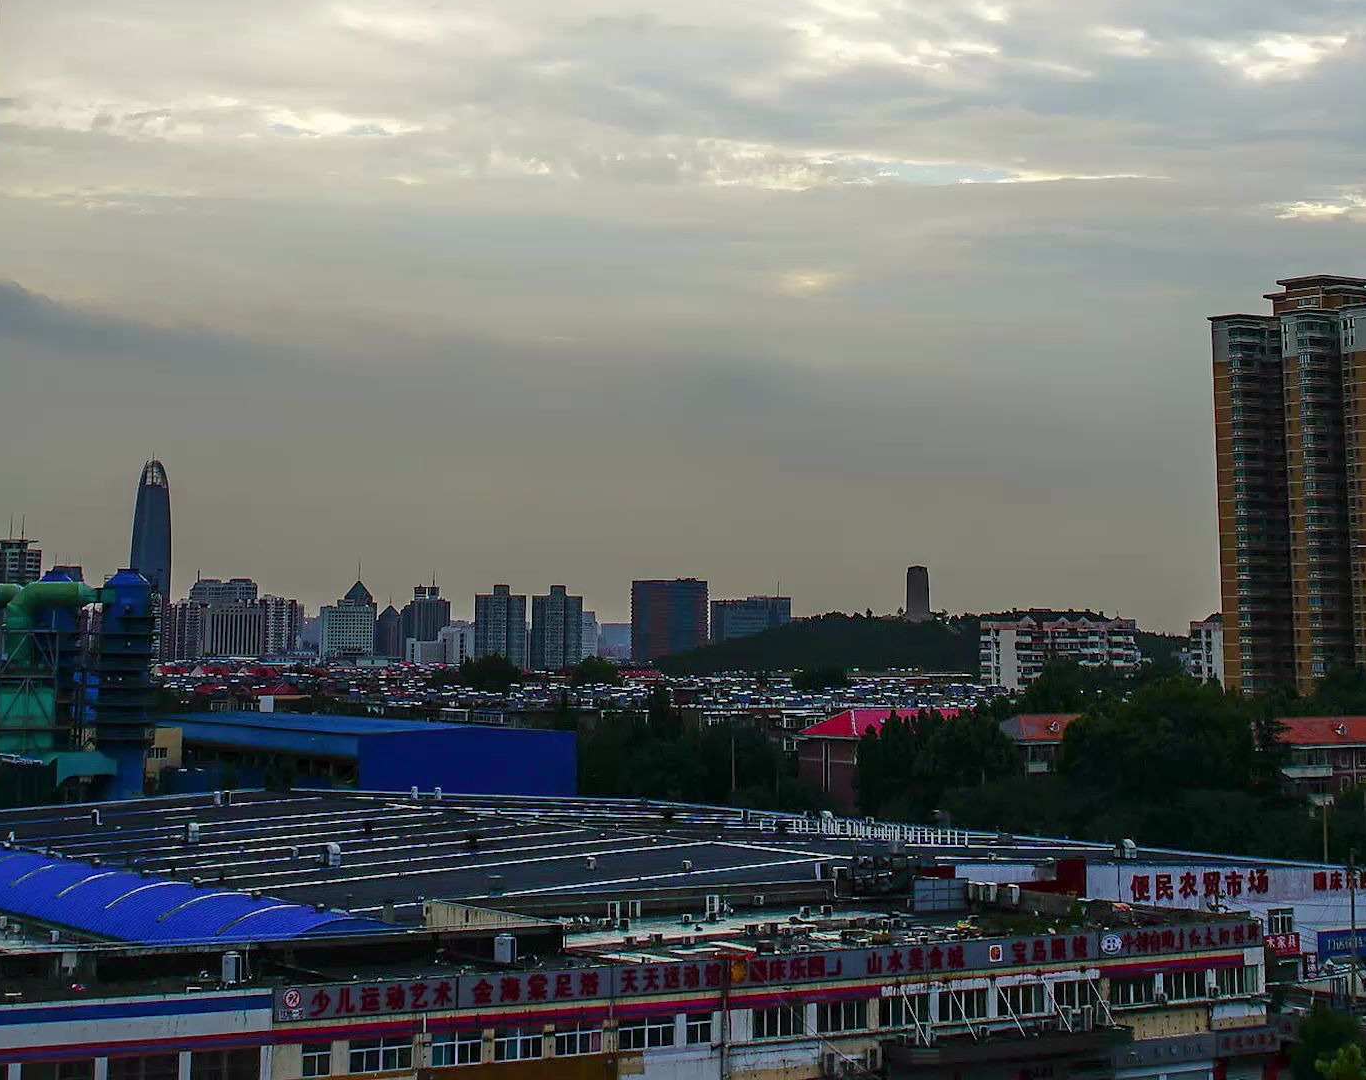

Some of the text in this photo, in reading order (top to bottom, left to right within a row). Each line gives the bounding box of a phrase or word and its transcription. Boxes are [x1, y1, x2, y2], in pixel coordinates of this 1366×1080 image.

[1131, 869, 1269, 902] 便民农贸市场
[1013, 937, 1088, 963] 宝岛眼镜
[311, 982, 453, 1017] 少儿运动艺术
